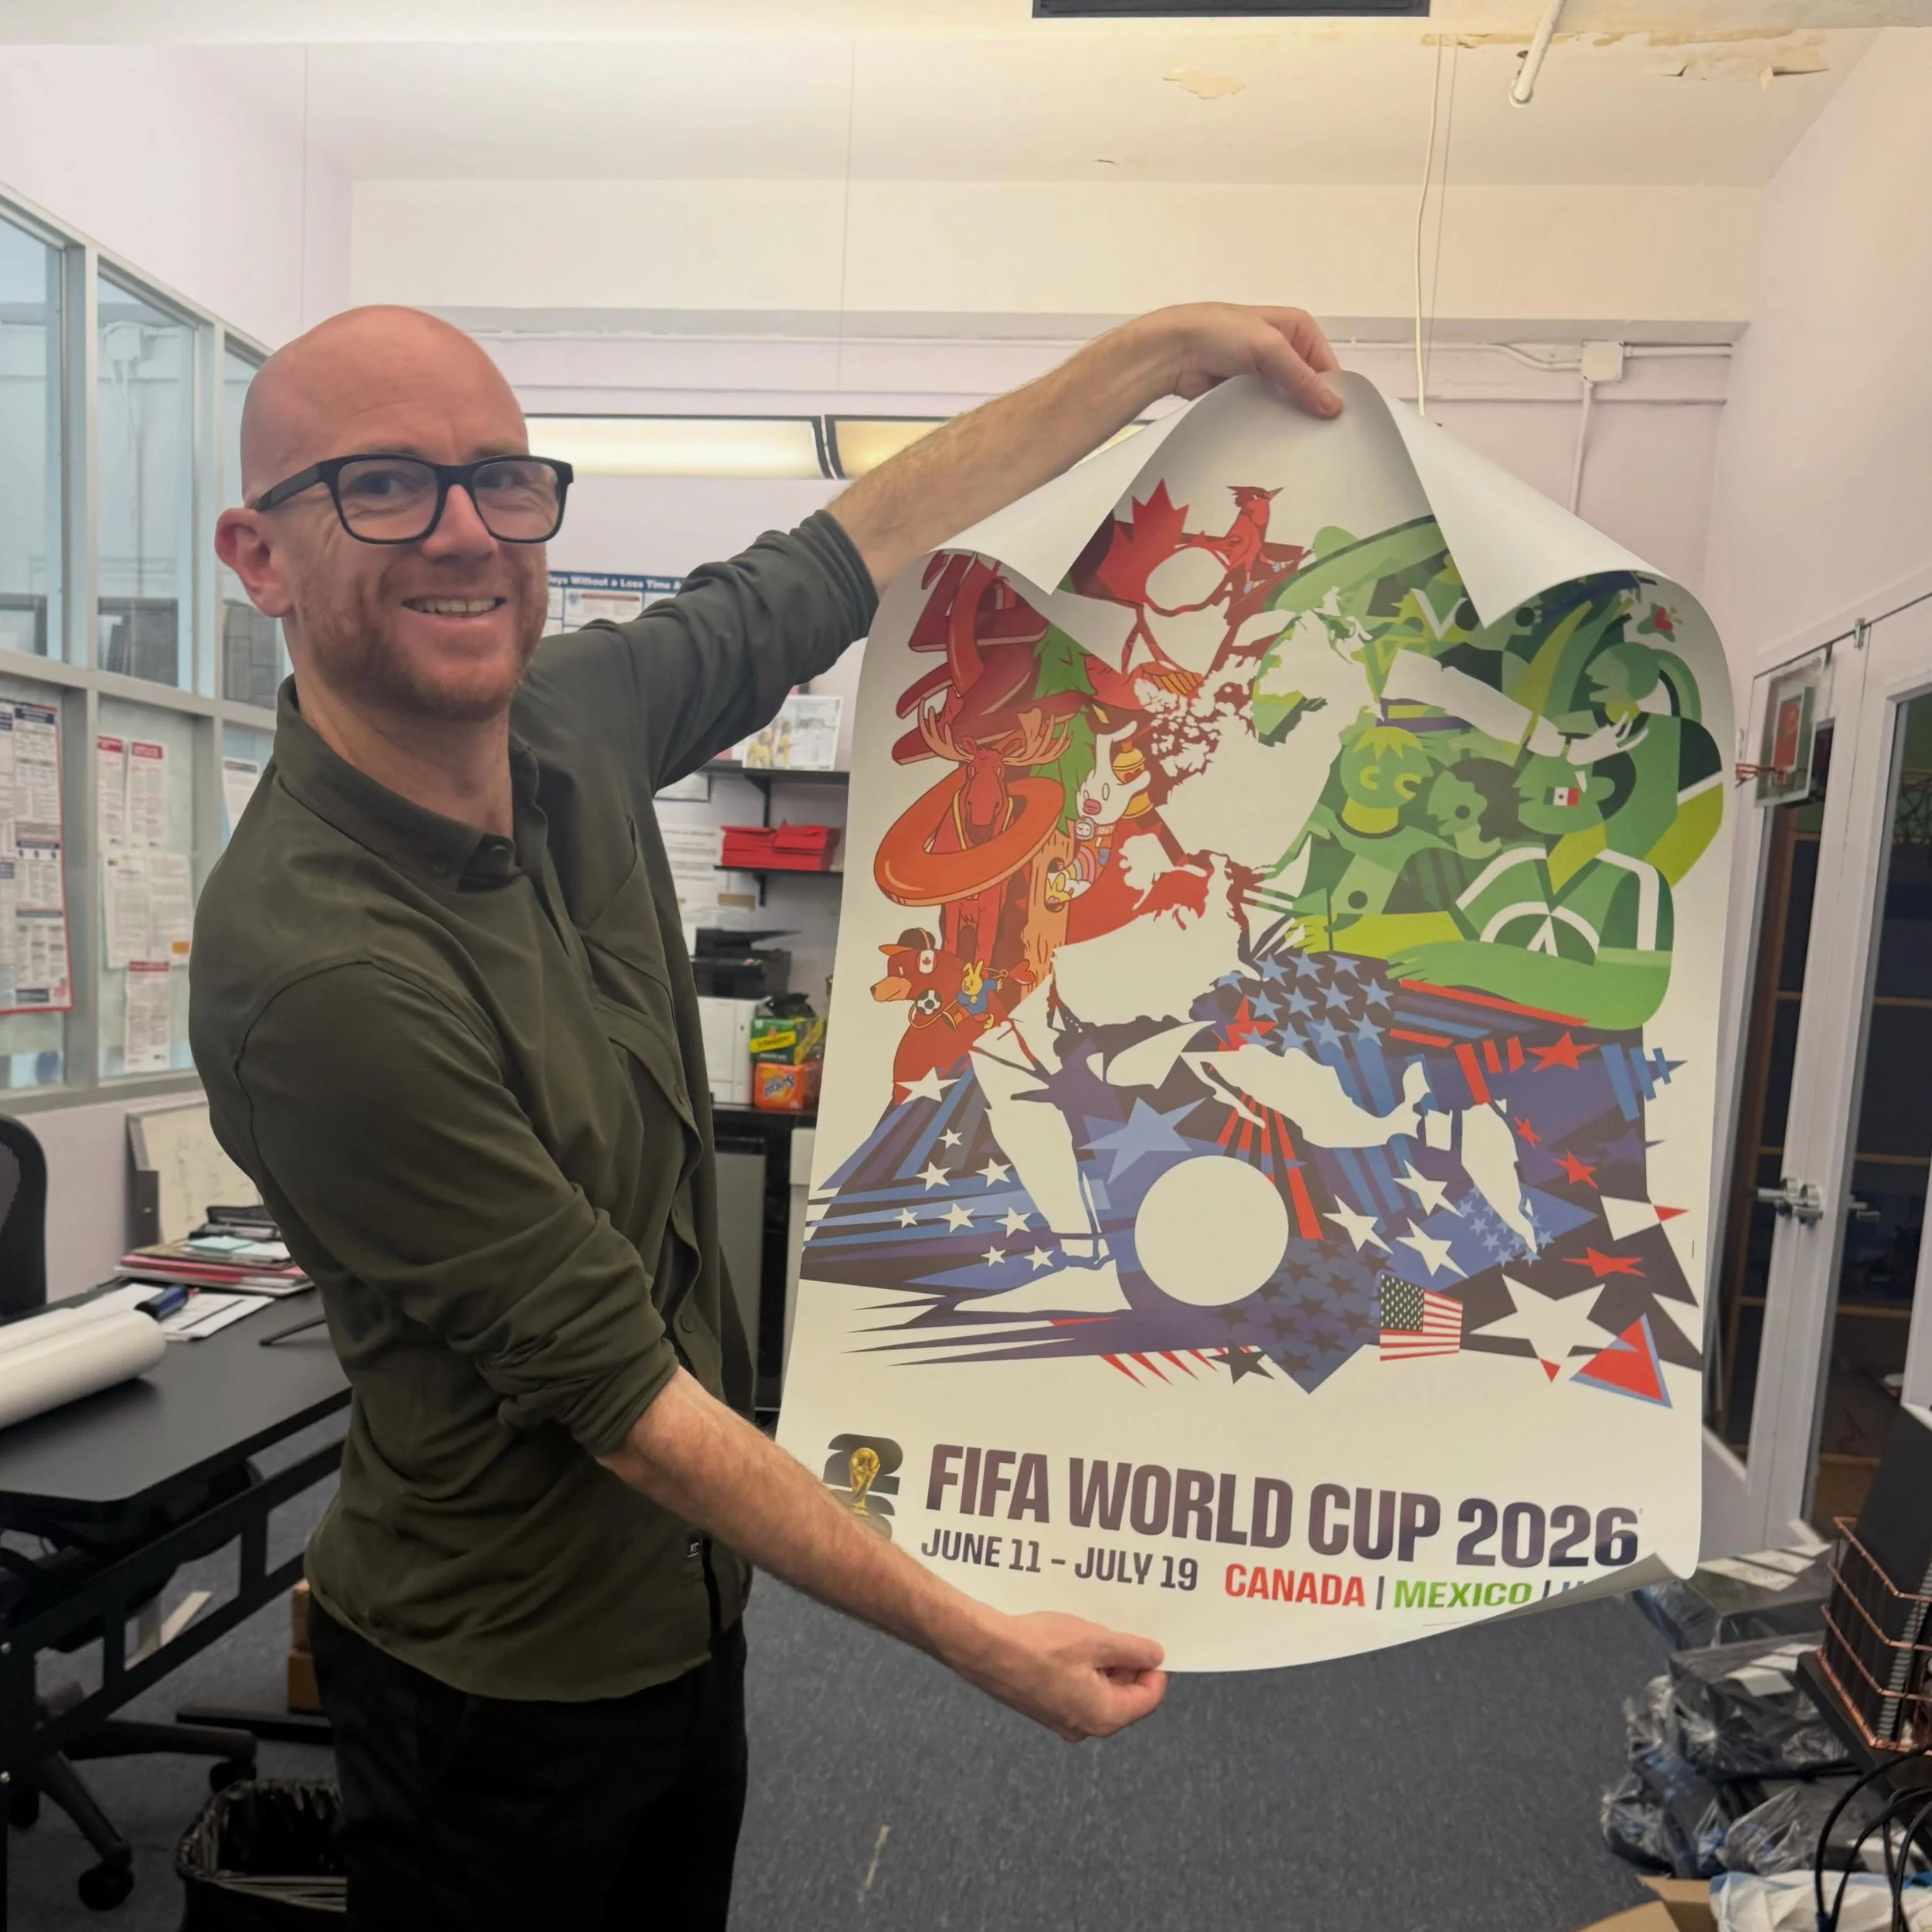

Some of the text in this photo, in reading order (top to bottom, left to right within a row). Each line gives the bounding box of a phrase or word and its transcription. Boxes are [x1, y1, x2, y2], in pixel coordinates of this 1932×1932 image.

[570, 576, 609, 586] Without
[646, 580, 672, 590] Time
[925, 1444, 1050, 1524] FIFA
[1069, 1457, 1294, 1549] WORLD
[1308, 1482, 1441, 1562] CUP
[1456, 1498, 1638, 1568] 2026
[920, 1529, 1003, 1568] JUNE
[1009, 1538, 1042, 1573] 11
[1074, 1546, 1154, 1586] JULY
[1160, 1555, 1199, 1591] 19
[1224, 1563, 1366, 1607] CANADA
[1393, 1579, 1532, 1609] MEXICO
